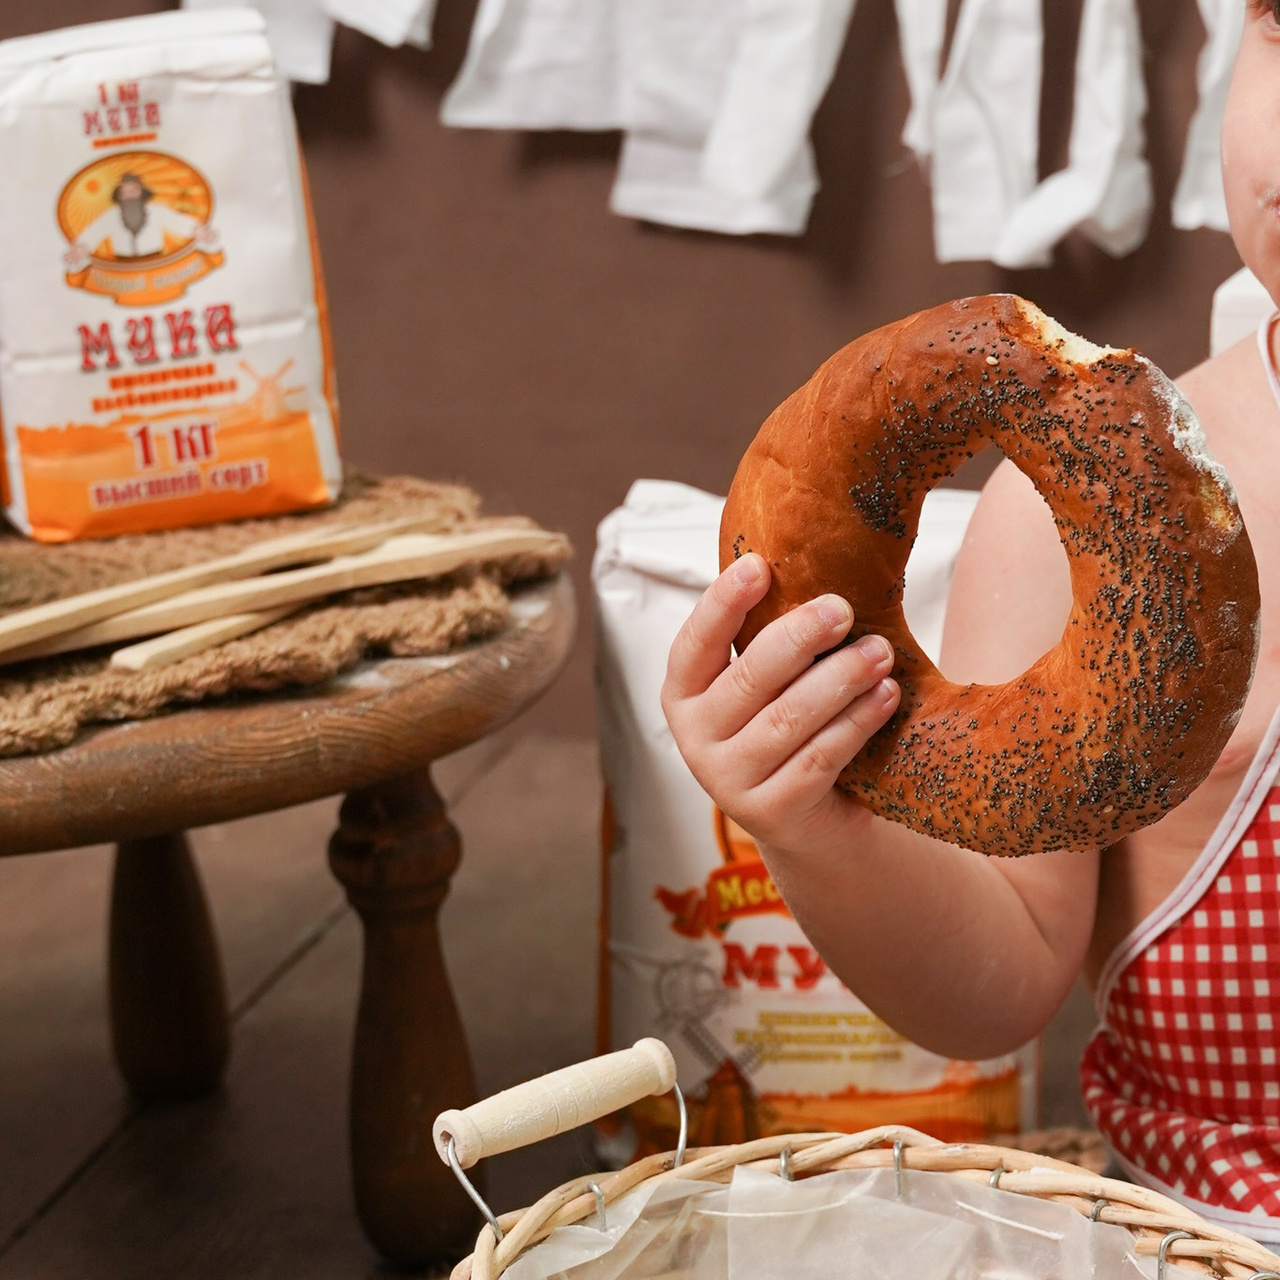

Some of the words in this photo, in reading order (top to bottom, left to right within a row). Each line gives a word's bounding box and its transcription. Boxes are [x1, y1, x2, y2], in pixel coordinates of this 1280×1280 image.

[78, 303, 240, 374] МУКА
[134, 424, 154, 468] 1
[716, 875, 779, 912] Мес
[722, 943, 850, 991] МУ
